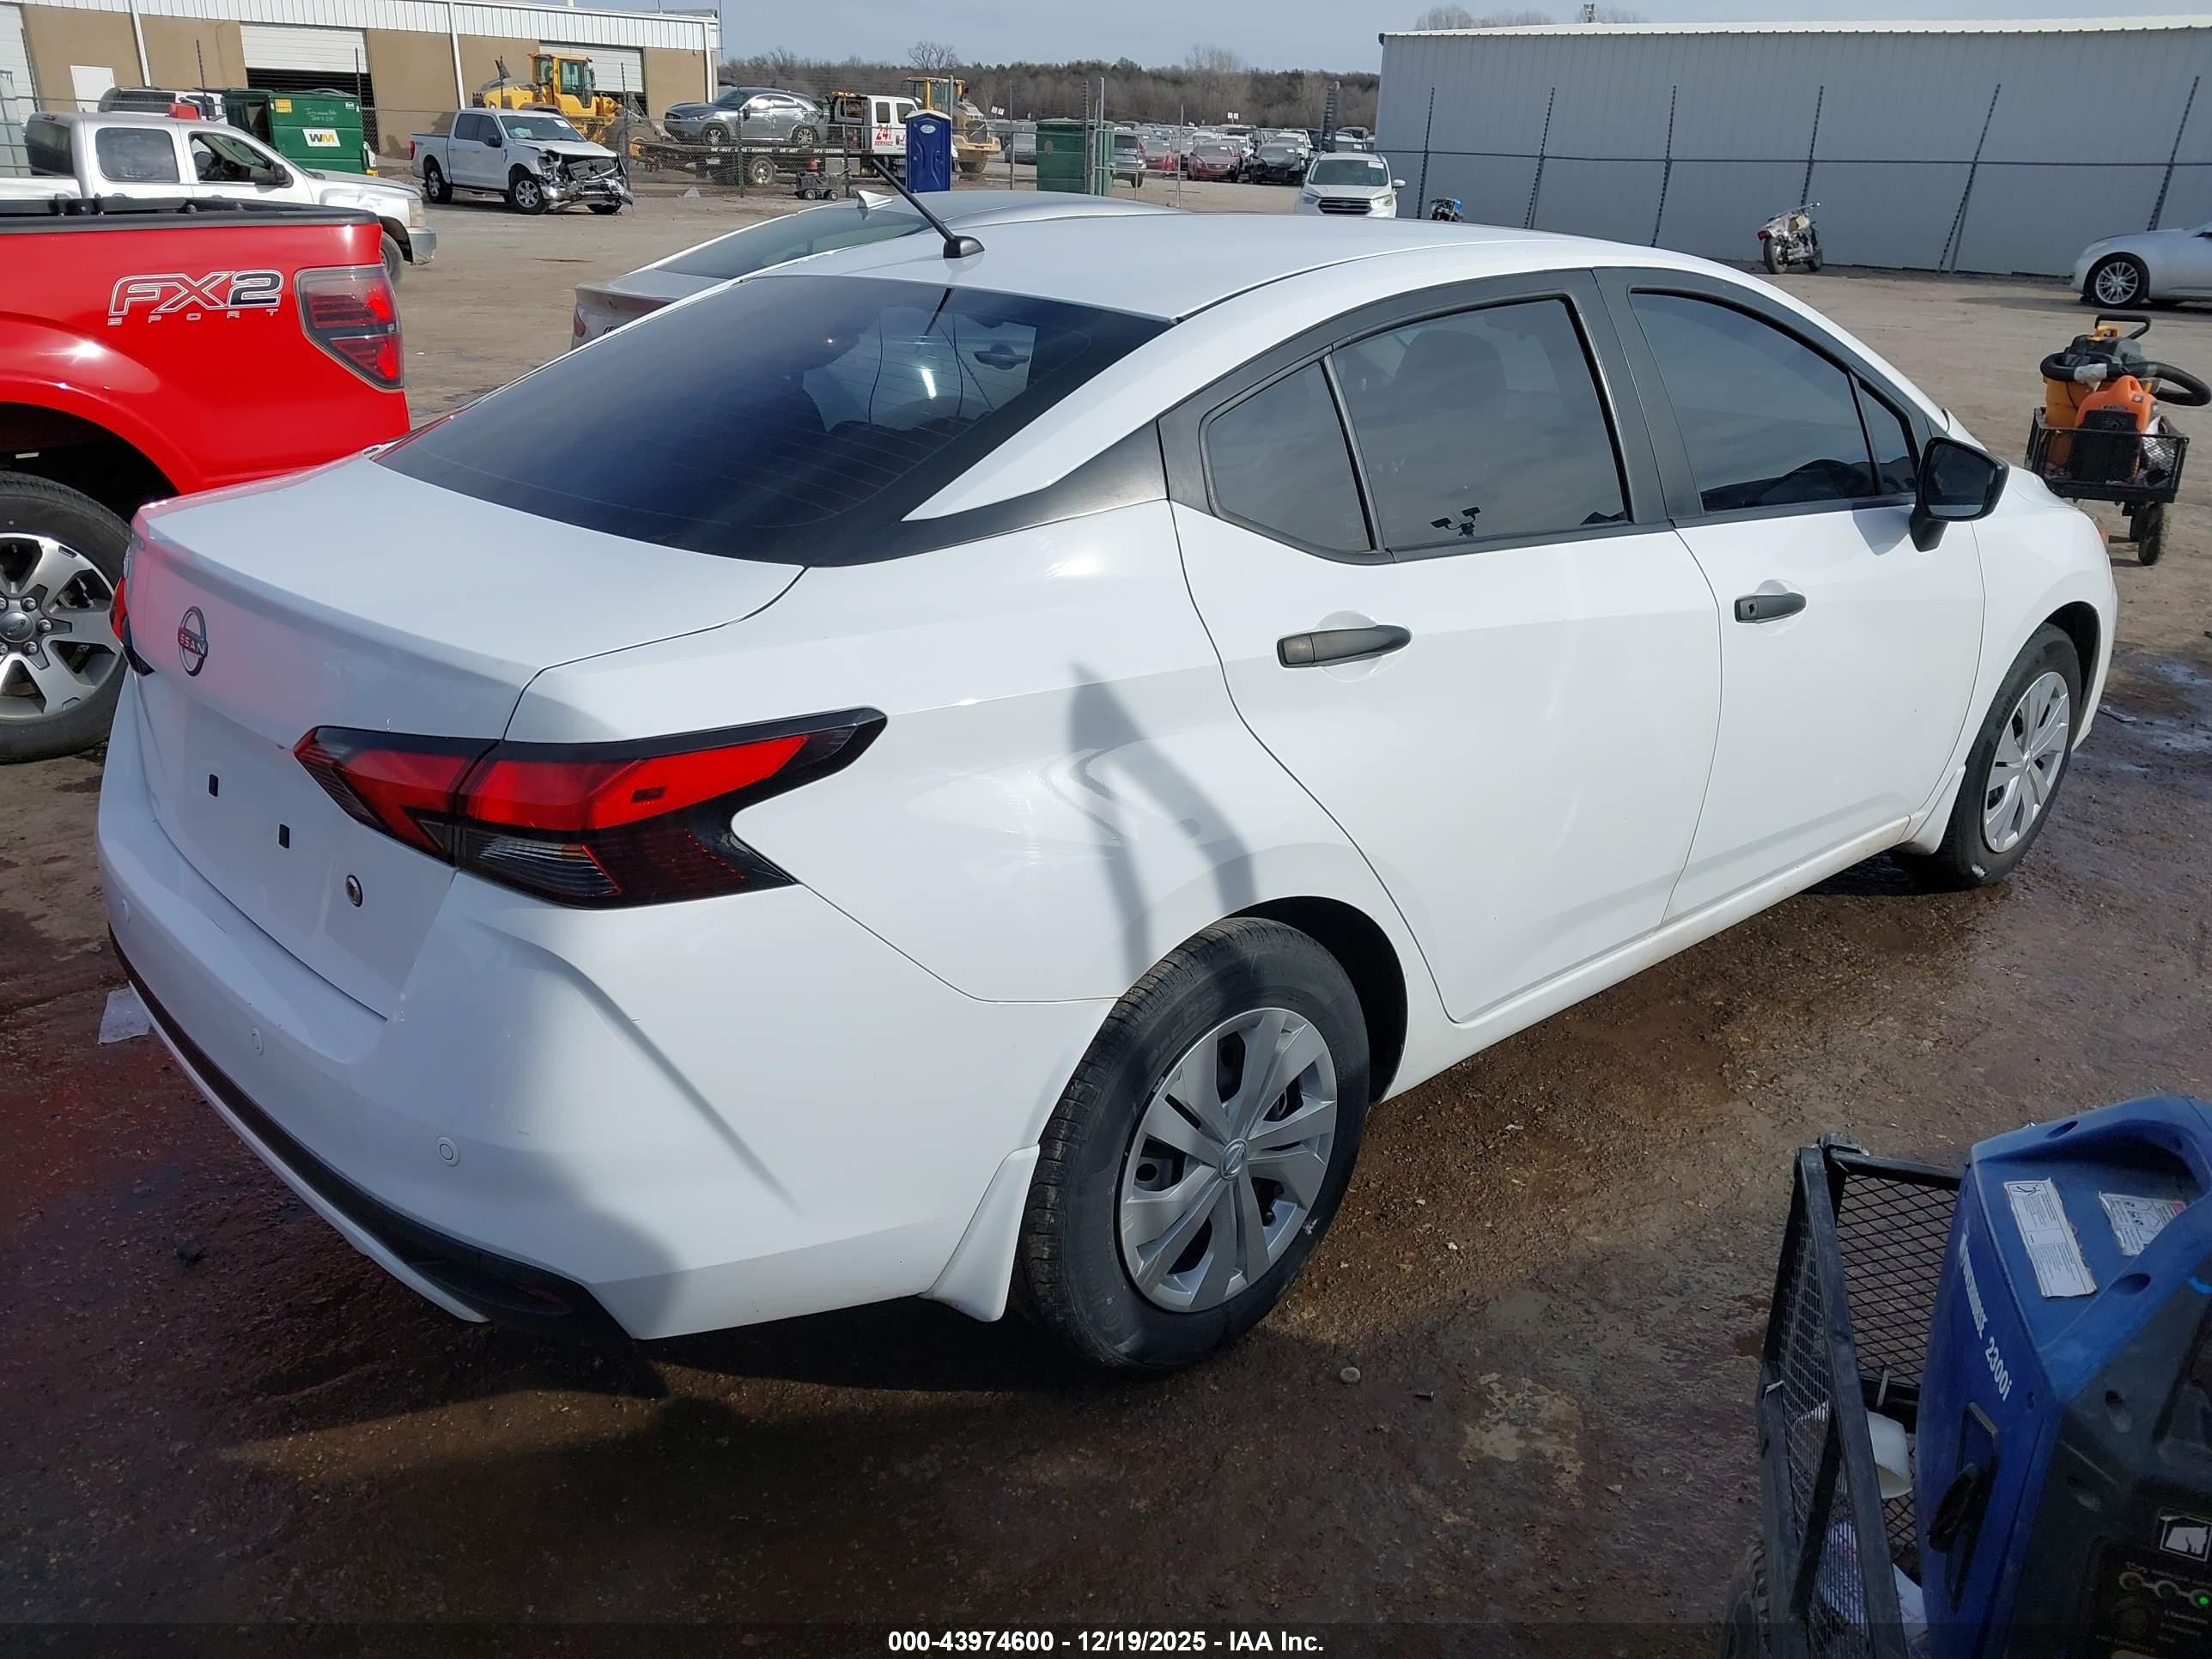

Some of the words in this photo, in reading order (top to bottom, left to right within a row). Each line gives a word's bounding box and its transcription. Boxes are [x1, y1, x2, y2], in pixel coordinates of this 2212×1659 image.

[309, 133, 335, 143] WM
[108, 269, 284, 315] FX2
[107, 308, 279, 325] SPORT
[1984, 1336, 2013, 1402] 2300i
